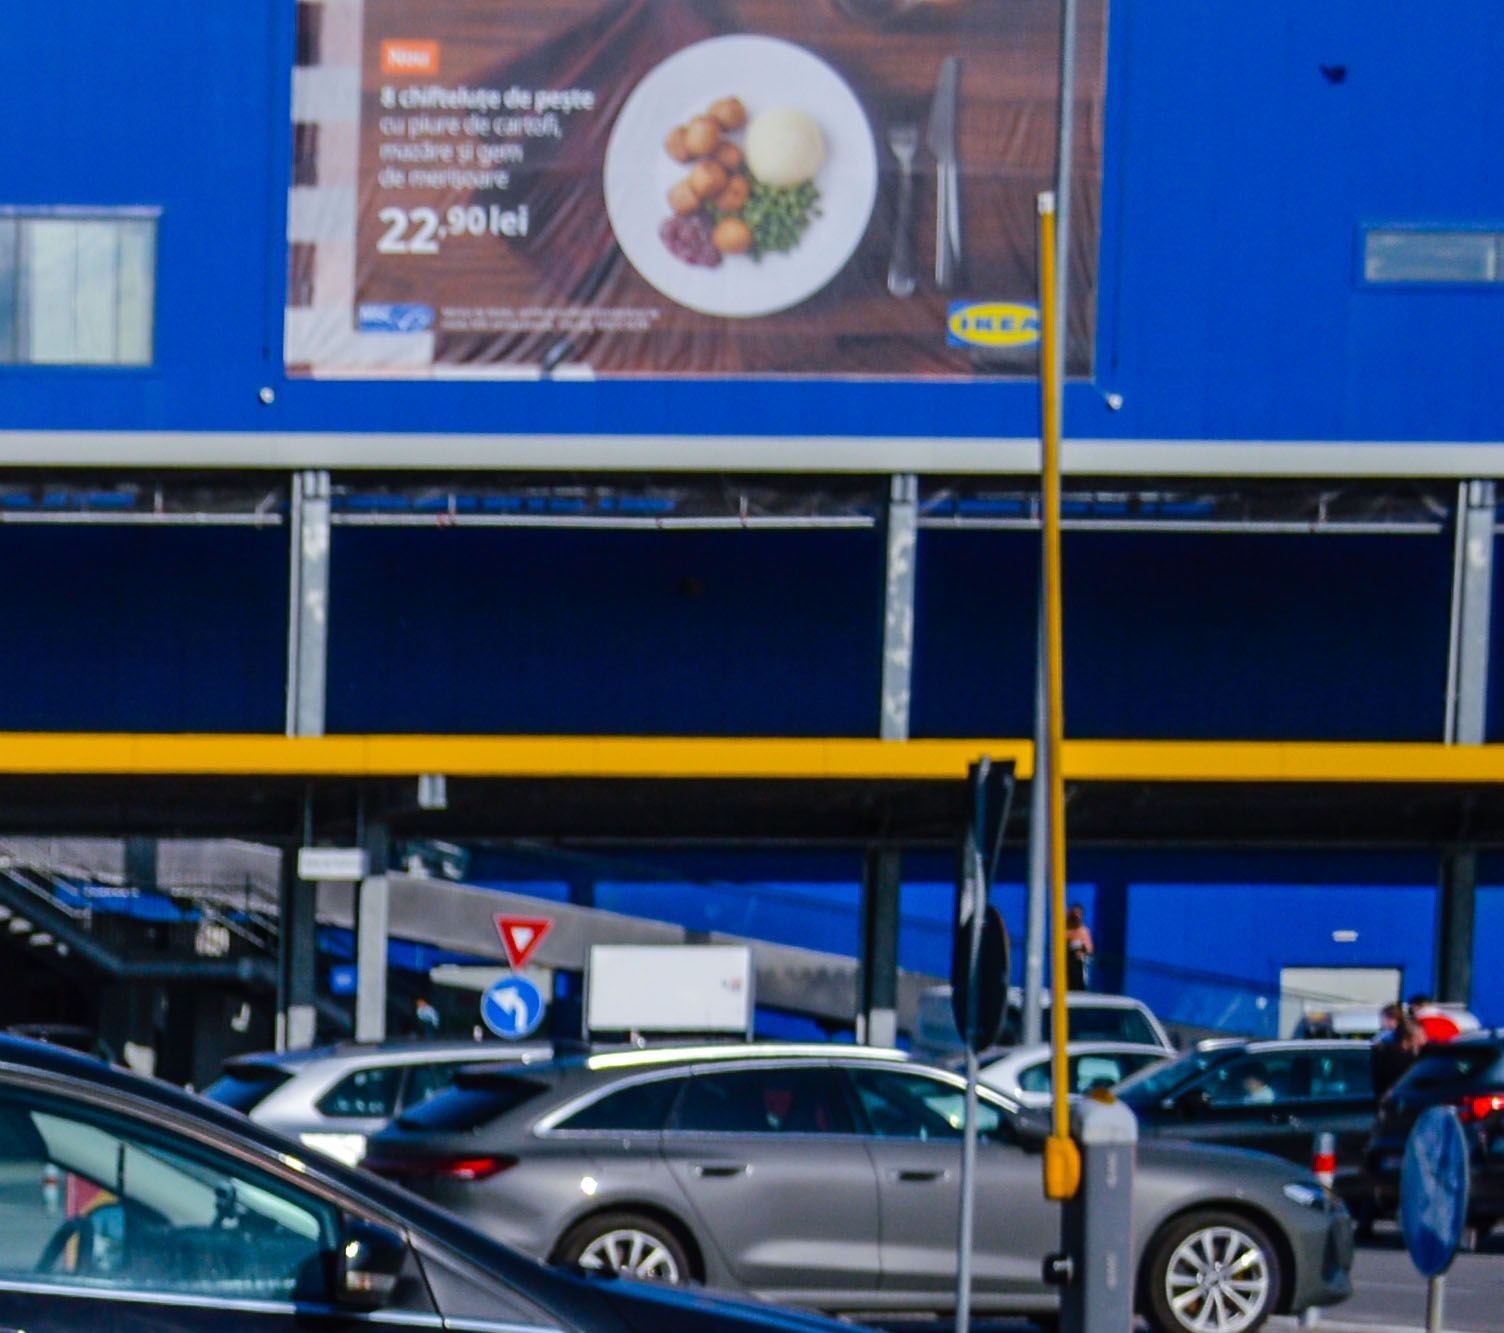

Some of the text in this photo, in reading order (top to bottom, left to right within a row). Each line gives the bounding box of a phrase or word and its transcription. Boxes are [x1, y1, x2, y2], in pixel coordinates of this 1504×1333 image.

[502, 85, 532, 109] de
[379, 117, 405, 136] cu
[462, 113, 490, 136] de
[377, 165, 406, 190] de
[490, 203, 529, 237] lei
